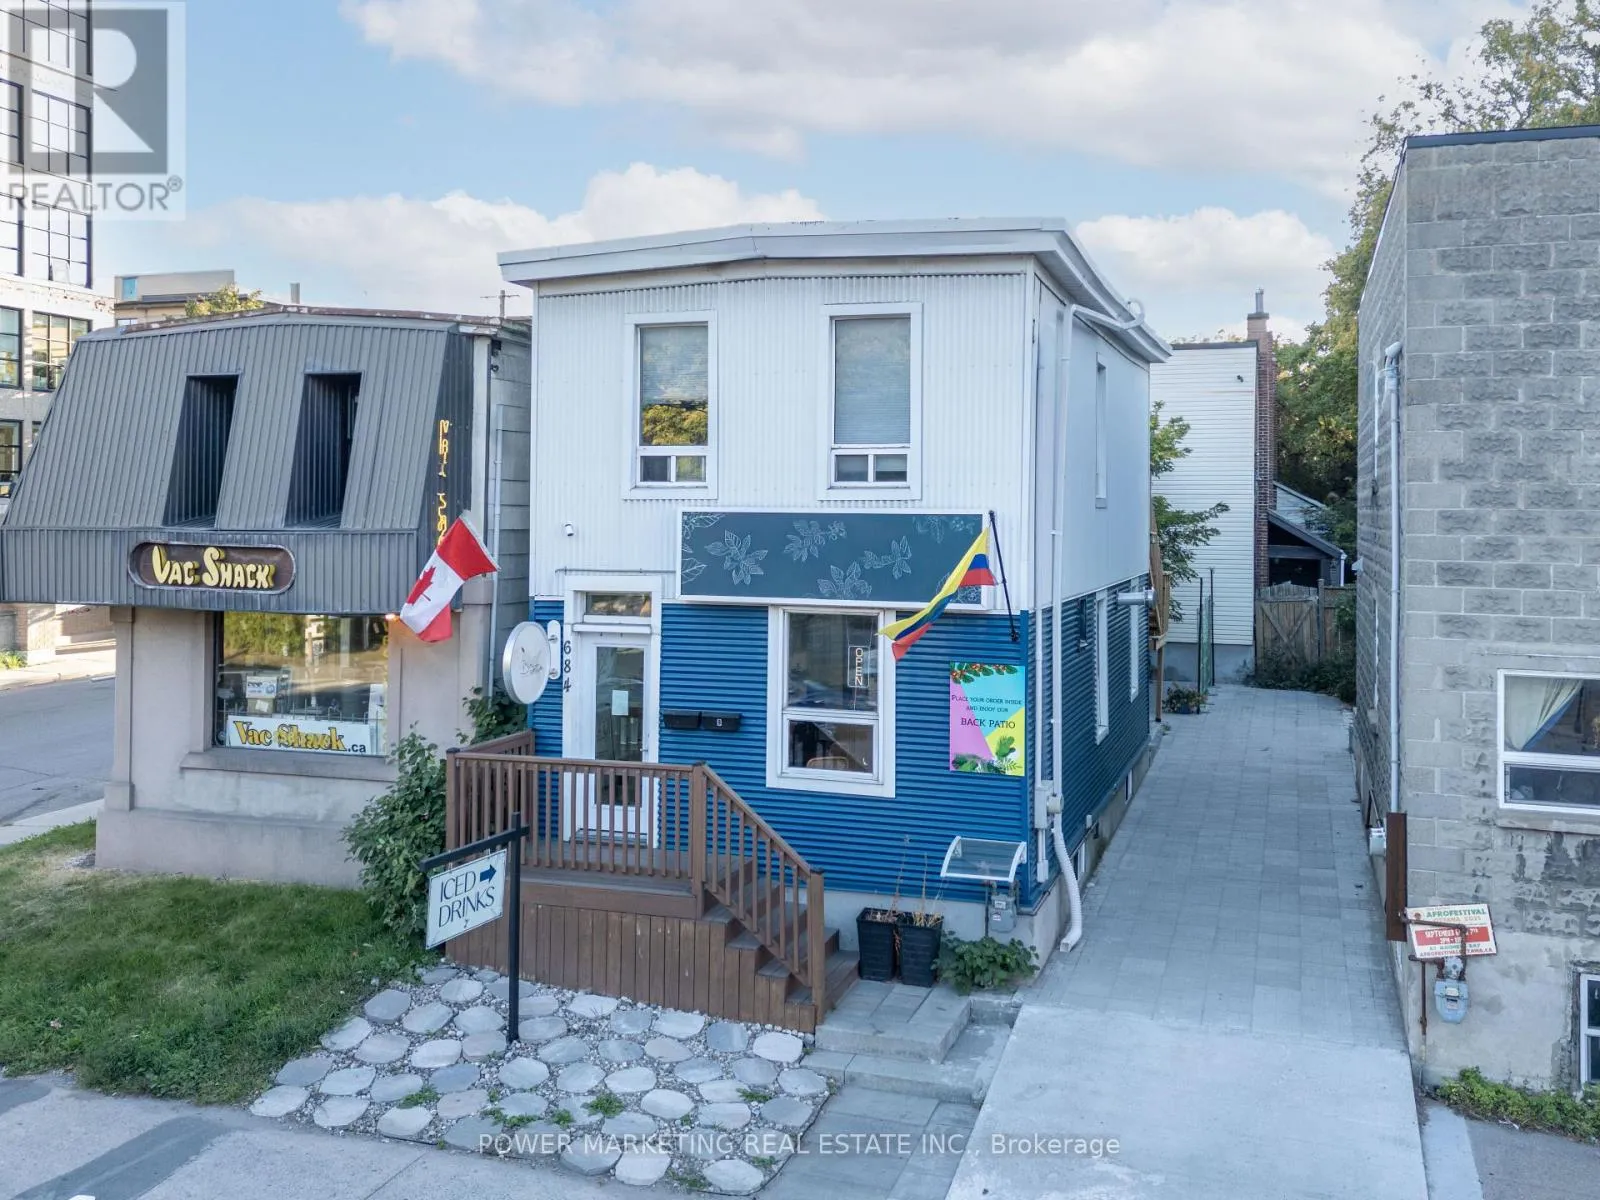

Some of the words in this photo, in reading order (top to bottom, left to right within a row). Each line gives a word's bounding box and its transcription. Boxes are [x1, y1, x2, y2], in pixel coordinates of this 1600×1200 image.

[563, 640, 572, 693] 684
[855, 647, 863, 686] OPEN
[233, 720, 272, 746] Vac
[961, 717, 986, 727] BACK
[989, 719, 1016, 729] PATIO
[440, 870, 477, 903] ICED
[438, 885, 495, 928] DRINKS
[1426, 908, 1486, 918] AFROFESTIVAL
